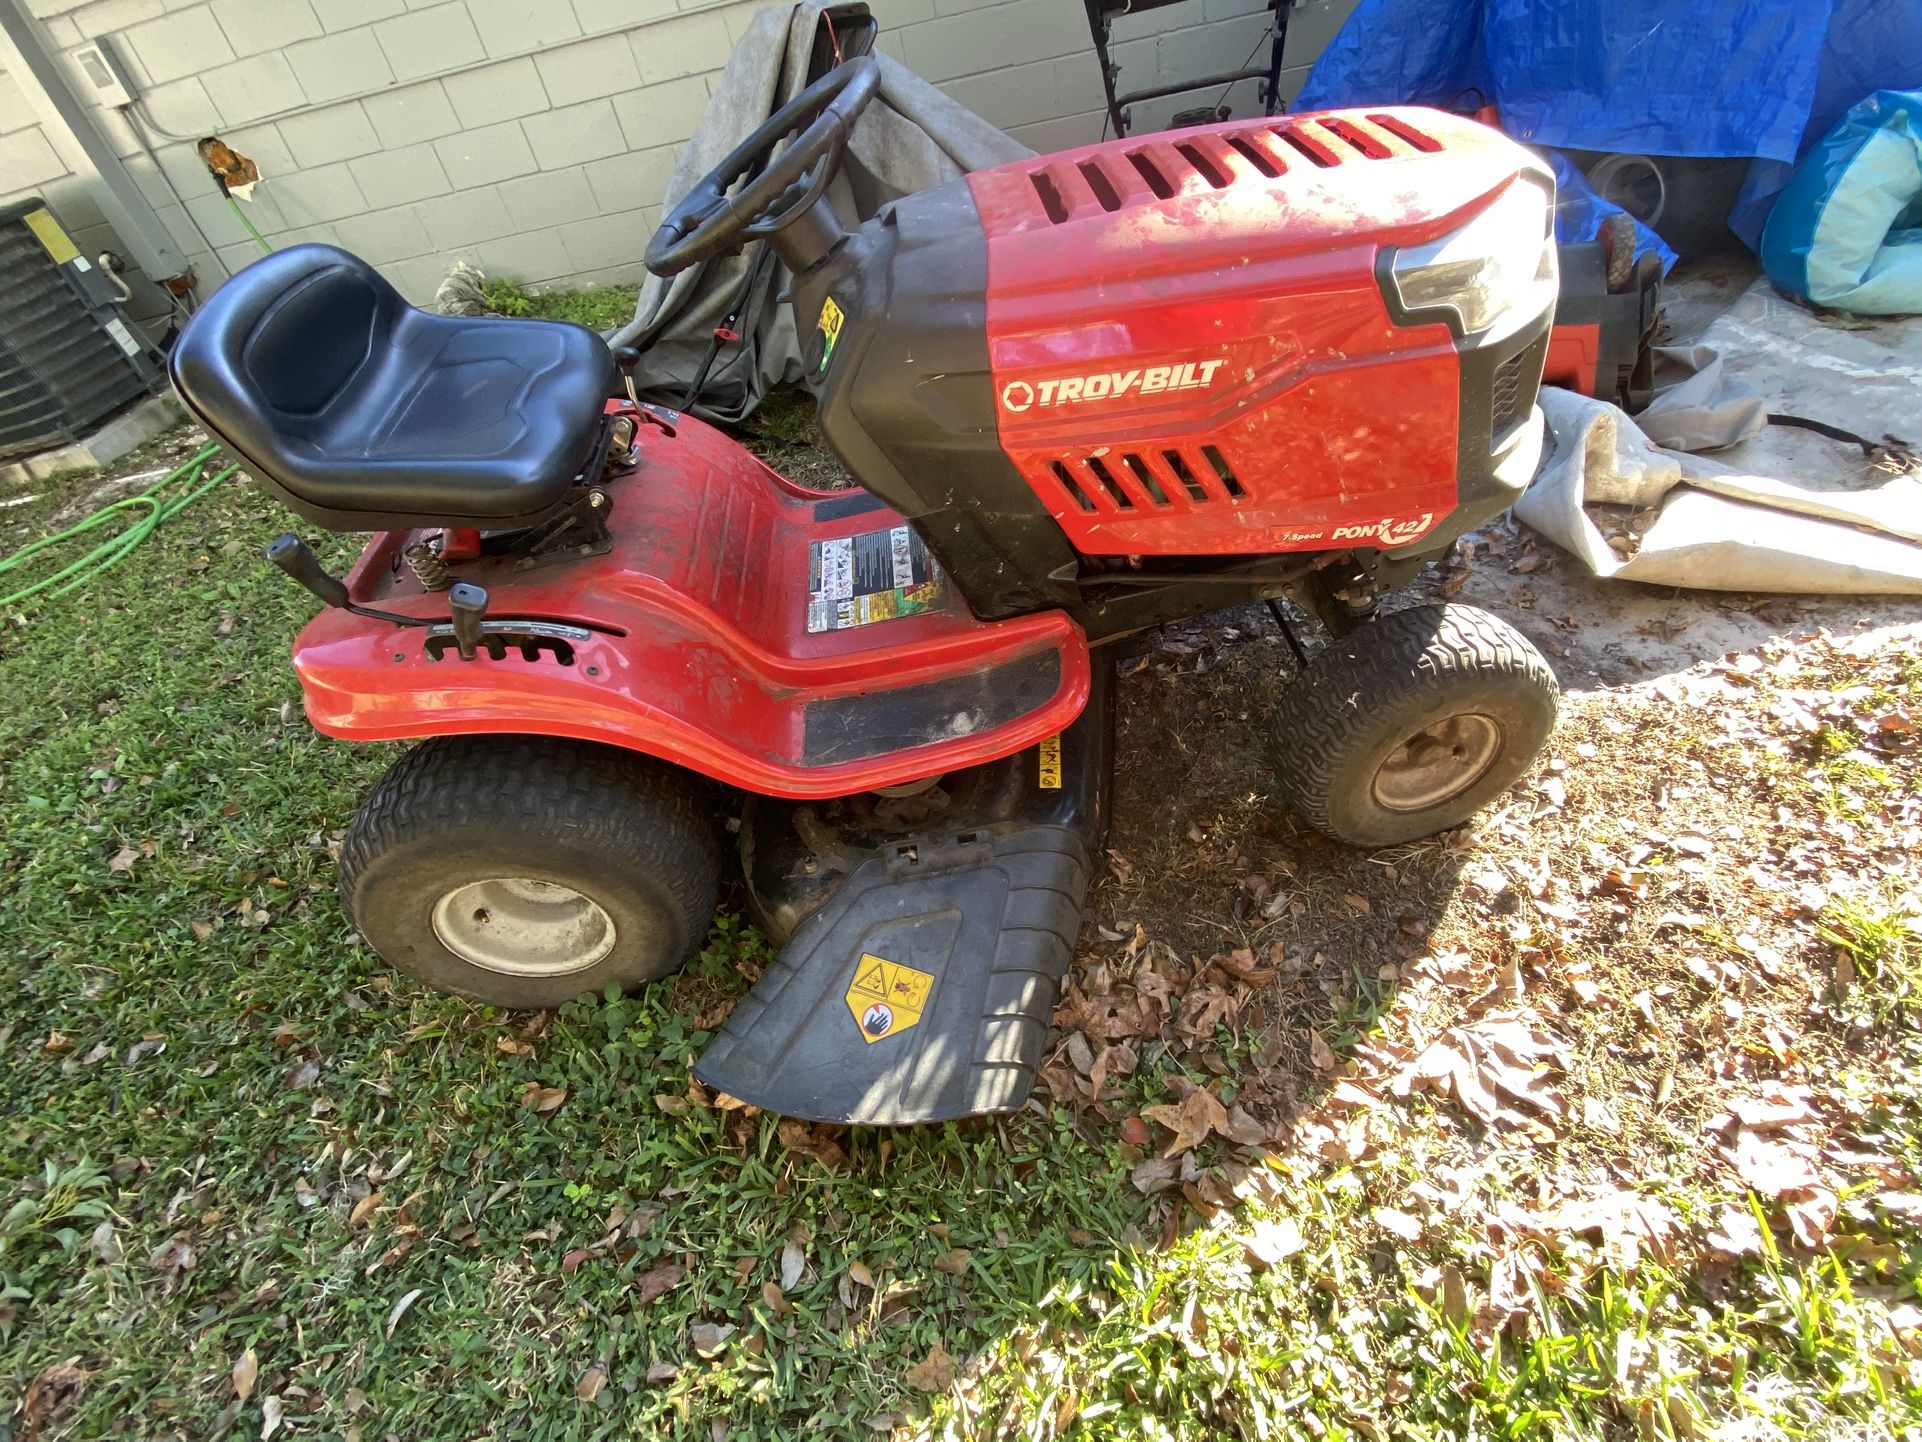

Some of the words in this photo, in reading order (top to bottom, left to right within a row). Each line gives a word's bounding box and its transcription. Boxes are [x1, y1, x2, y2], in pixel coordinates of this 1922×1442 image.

[1037, 360, 1224, 407] TROY-BILT
[1292, 532, 1323, 541] Speed
[1331, 522, 1392, 540] PONY
